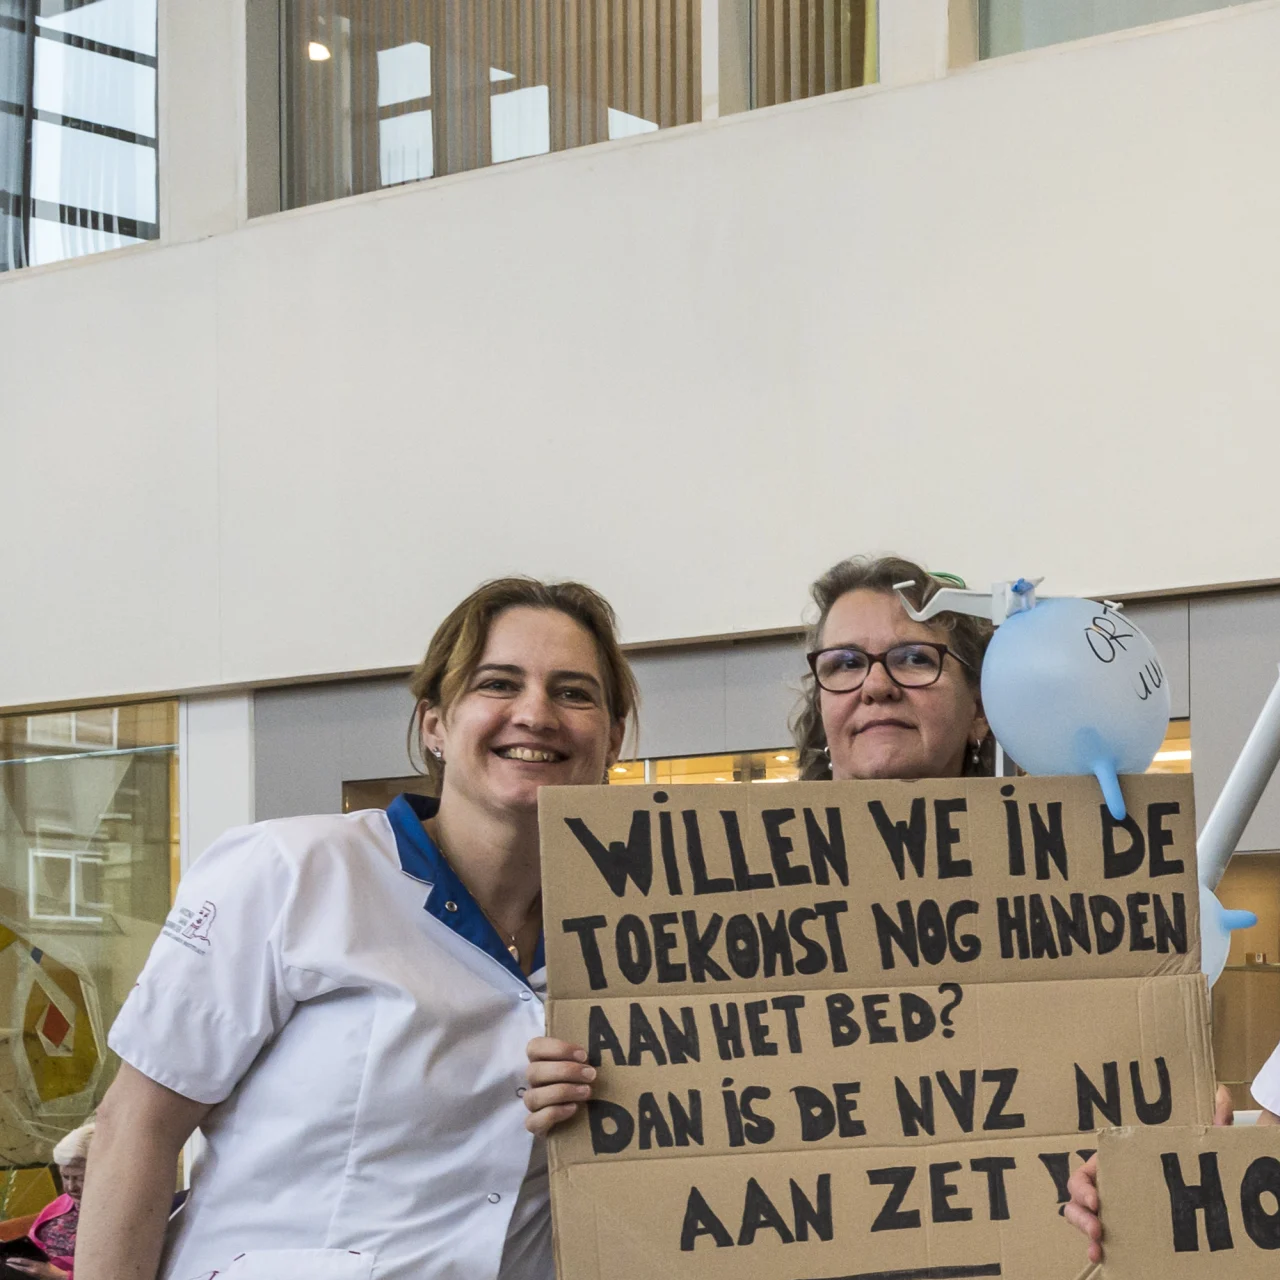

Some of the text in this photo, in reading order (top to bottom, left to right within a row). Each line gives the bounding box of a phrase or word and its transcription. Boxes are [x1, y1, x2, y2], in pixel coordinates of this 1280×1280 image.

[868, 798, 972, 880] WE
[1100, 801, 1184, 878] DE
[561, 892, 1187, 990] TOEKOMST NOG HANDEN
[588, 982, 963, 1066] AAN HET BED?
[588, 1090, 704, 1154] DAN
[790, 1081, 866, 1142] DE
[894, 1068, 1025, 1137] NVZ
[1073, 1056, 1172, 1131] NU
[680, 1156, 1016, 1251] AAN ZET
